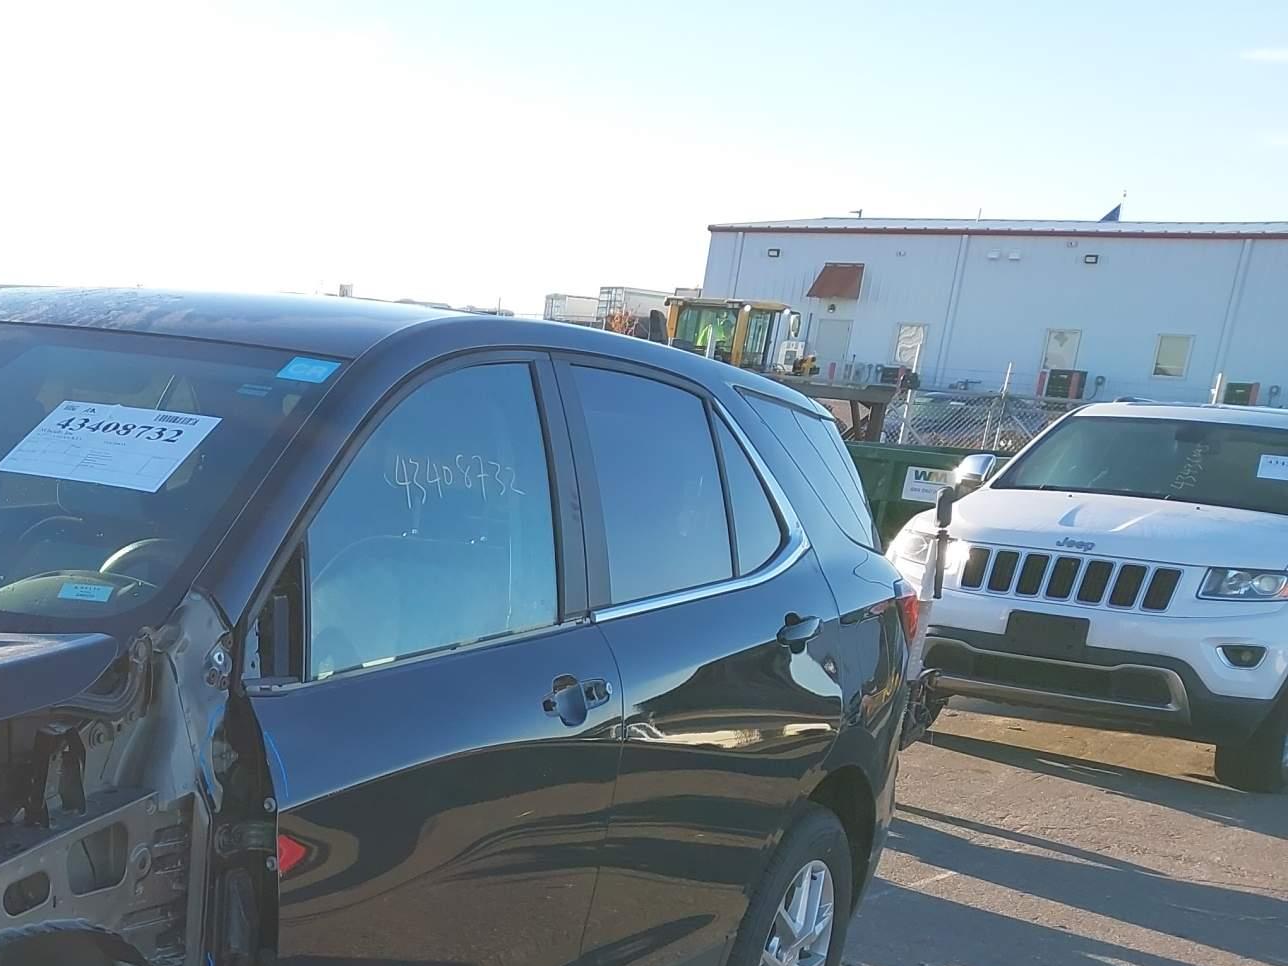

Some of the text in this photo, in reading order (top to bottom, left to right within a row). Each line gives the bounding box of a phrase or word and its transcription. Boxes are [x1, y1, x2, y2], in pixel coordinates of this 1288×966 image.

[56, 416, 185, 444] 43408732
[394, 454, 527, 509] 43408732
[1055, 537, 1096, 552] Jeep
